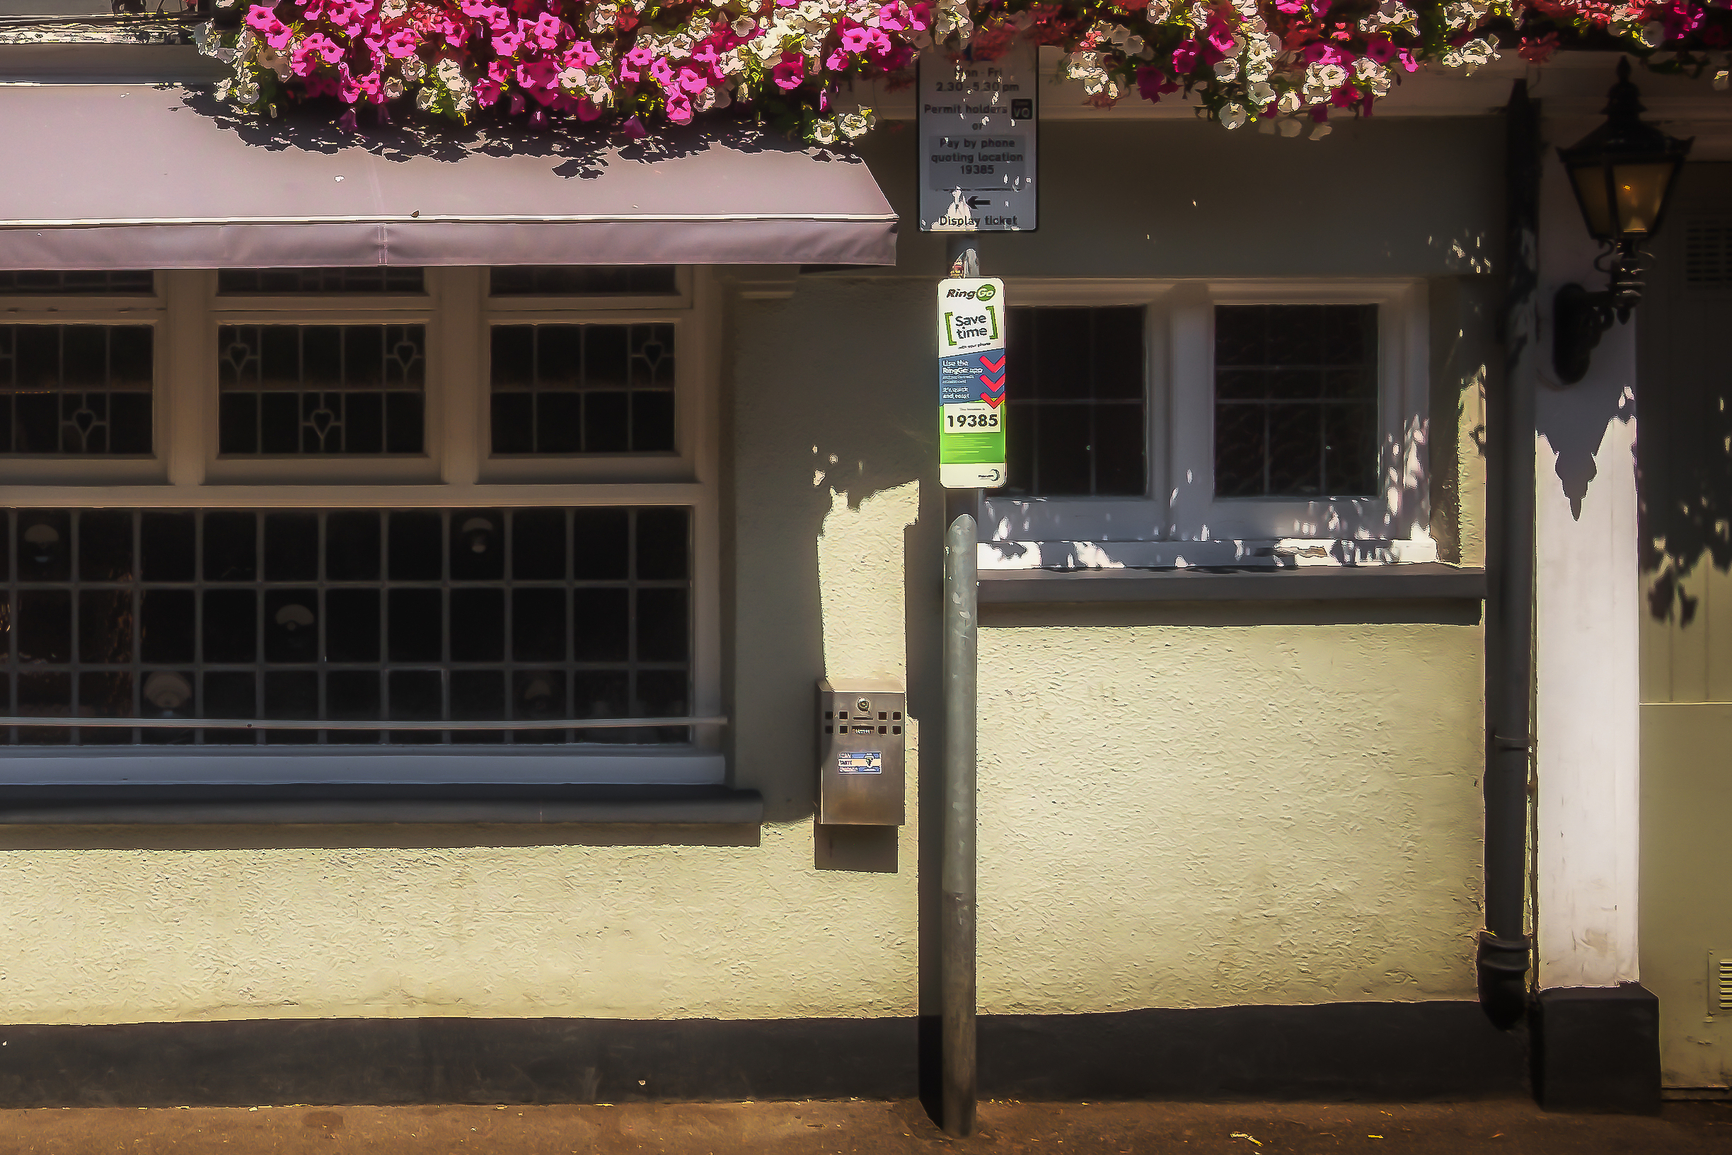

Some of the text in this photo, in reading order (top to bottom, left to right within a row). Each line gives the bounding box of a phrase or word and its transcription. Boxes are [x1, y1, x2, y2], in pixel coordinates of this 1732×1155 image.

[987, 67, 1003, 77] Fri
[935, 82, 964, 92] 2.30
[972, 82, 1000, 92] 5.30
[1002, 84, 1020, 93] pm
[924, 104, 1008, 114] Permit holders
[971, 122, 983, 130] or
[939, 138, 1015, 149] Pay by phone
[931, 152, 1024, 163] quoting location
[960, 165, 995, 175] 19385
[939, 216, 1018, 227] Display ticket
[946, 287, 995, 300] RingGo
[955, 314, 987, 327] Save
[956, 326, 988, 340] time
[946, 414, 999, 428] 19385
